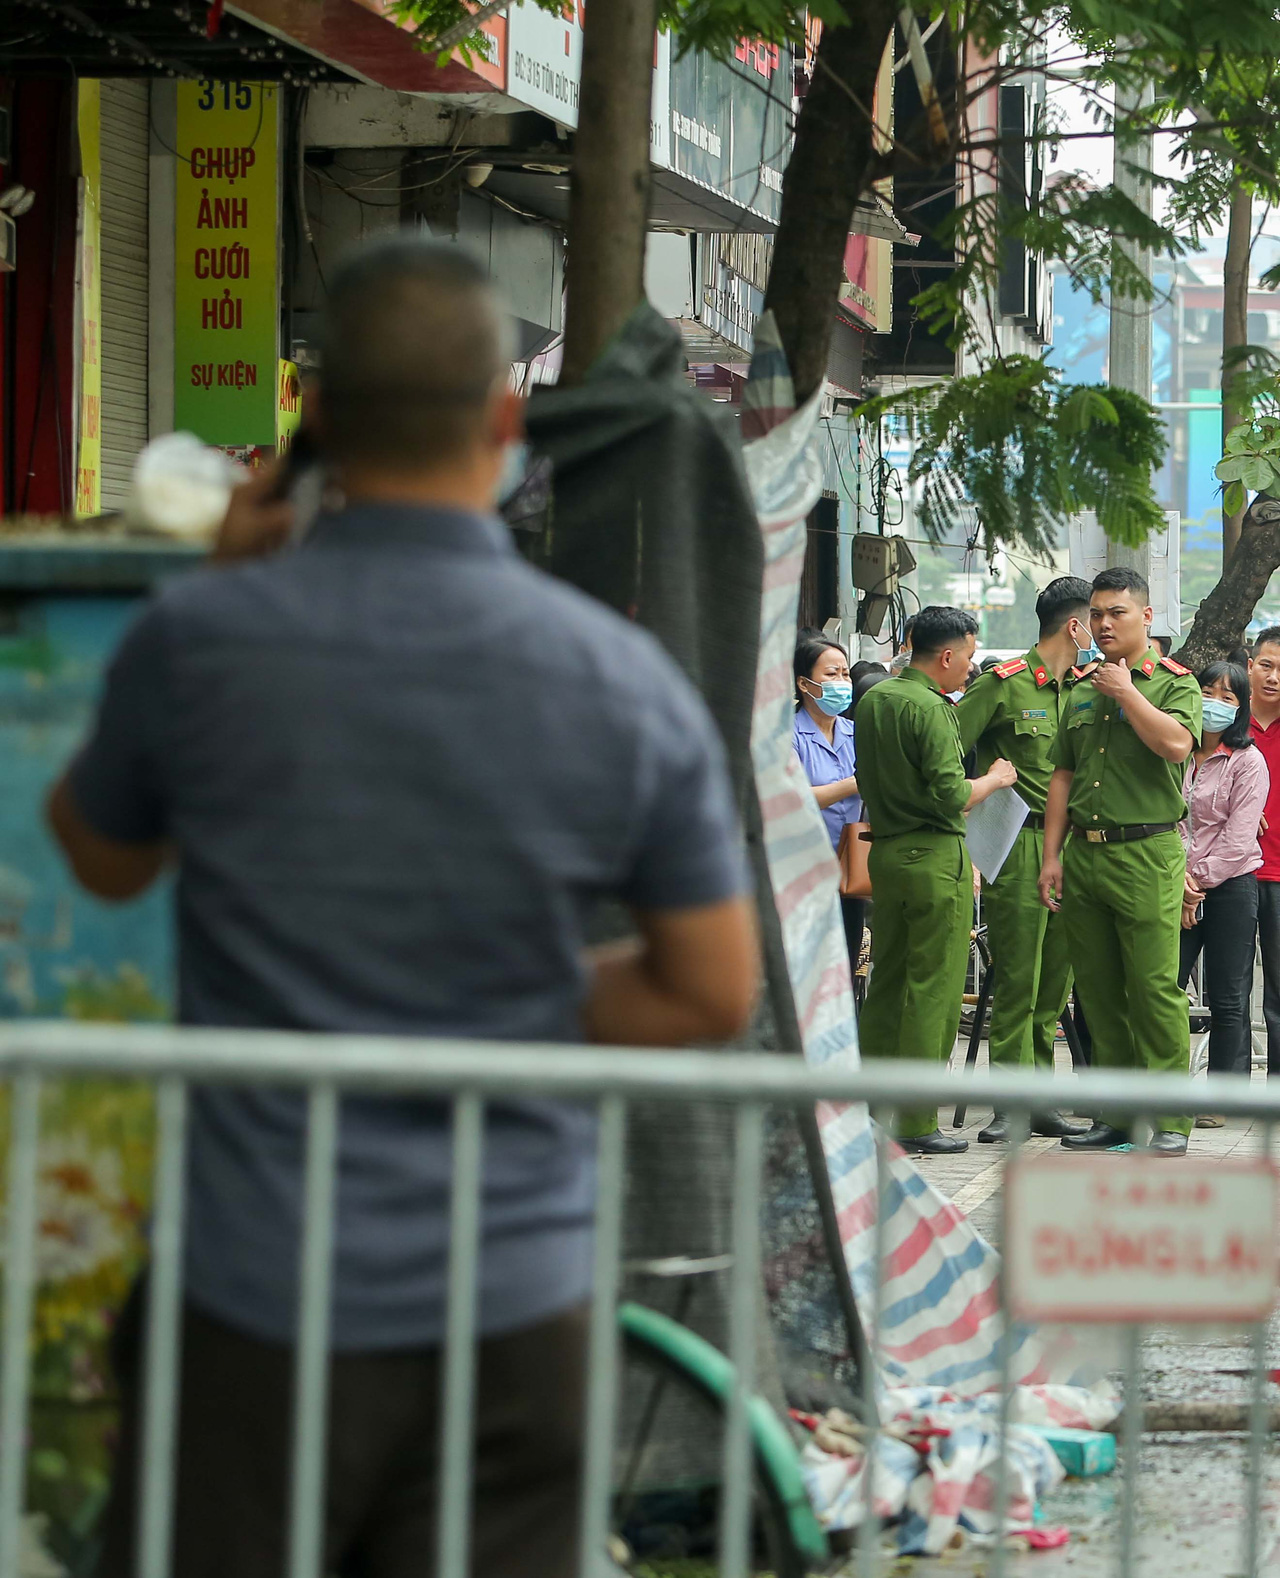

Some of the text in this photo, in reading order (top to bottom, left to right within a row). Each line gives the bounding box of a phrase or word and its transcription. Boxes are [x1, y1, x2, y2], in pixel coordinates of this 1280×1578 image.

[198, 80, 252, 110] 315
[191, 147, 256, 185] CHỤP
[197, 188, 248, 229] ẢNH
[195, 241, 250, 279] CƯỚI
[202, 288, 243, 330] HỎI
[191, 359, 257, 391] SỰ KIỆN
